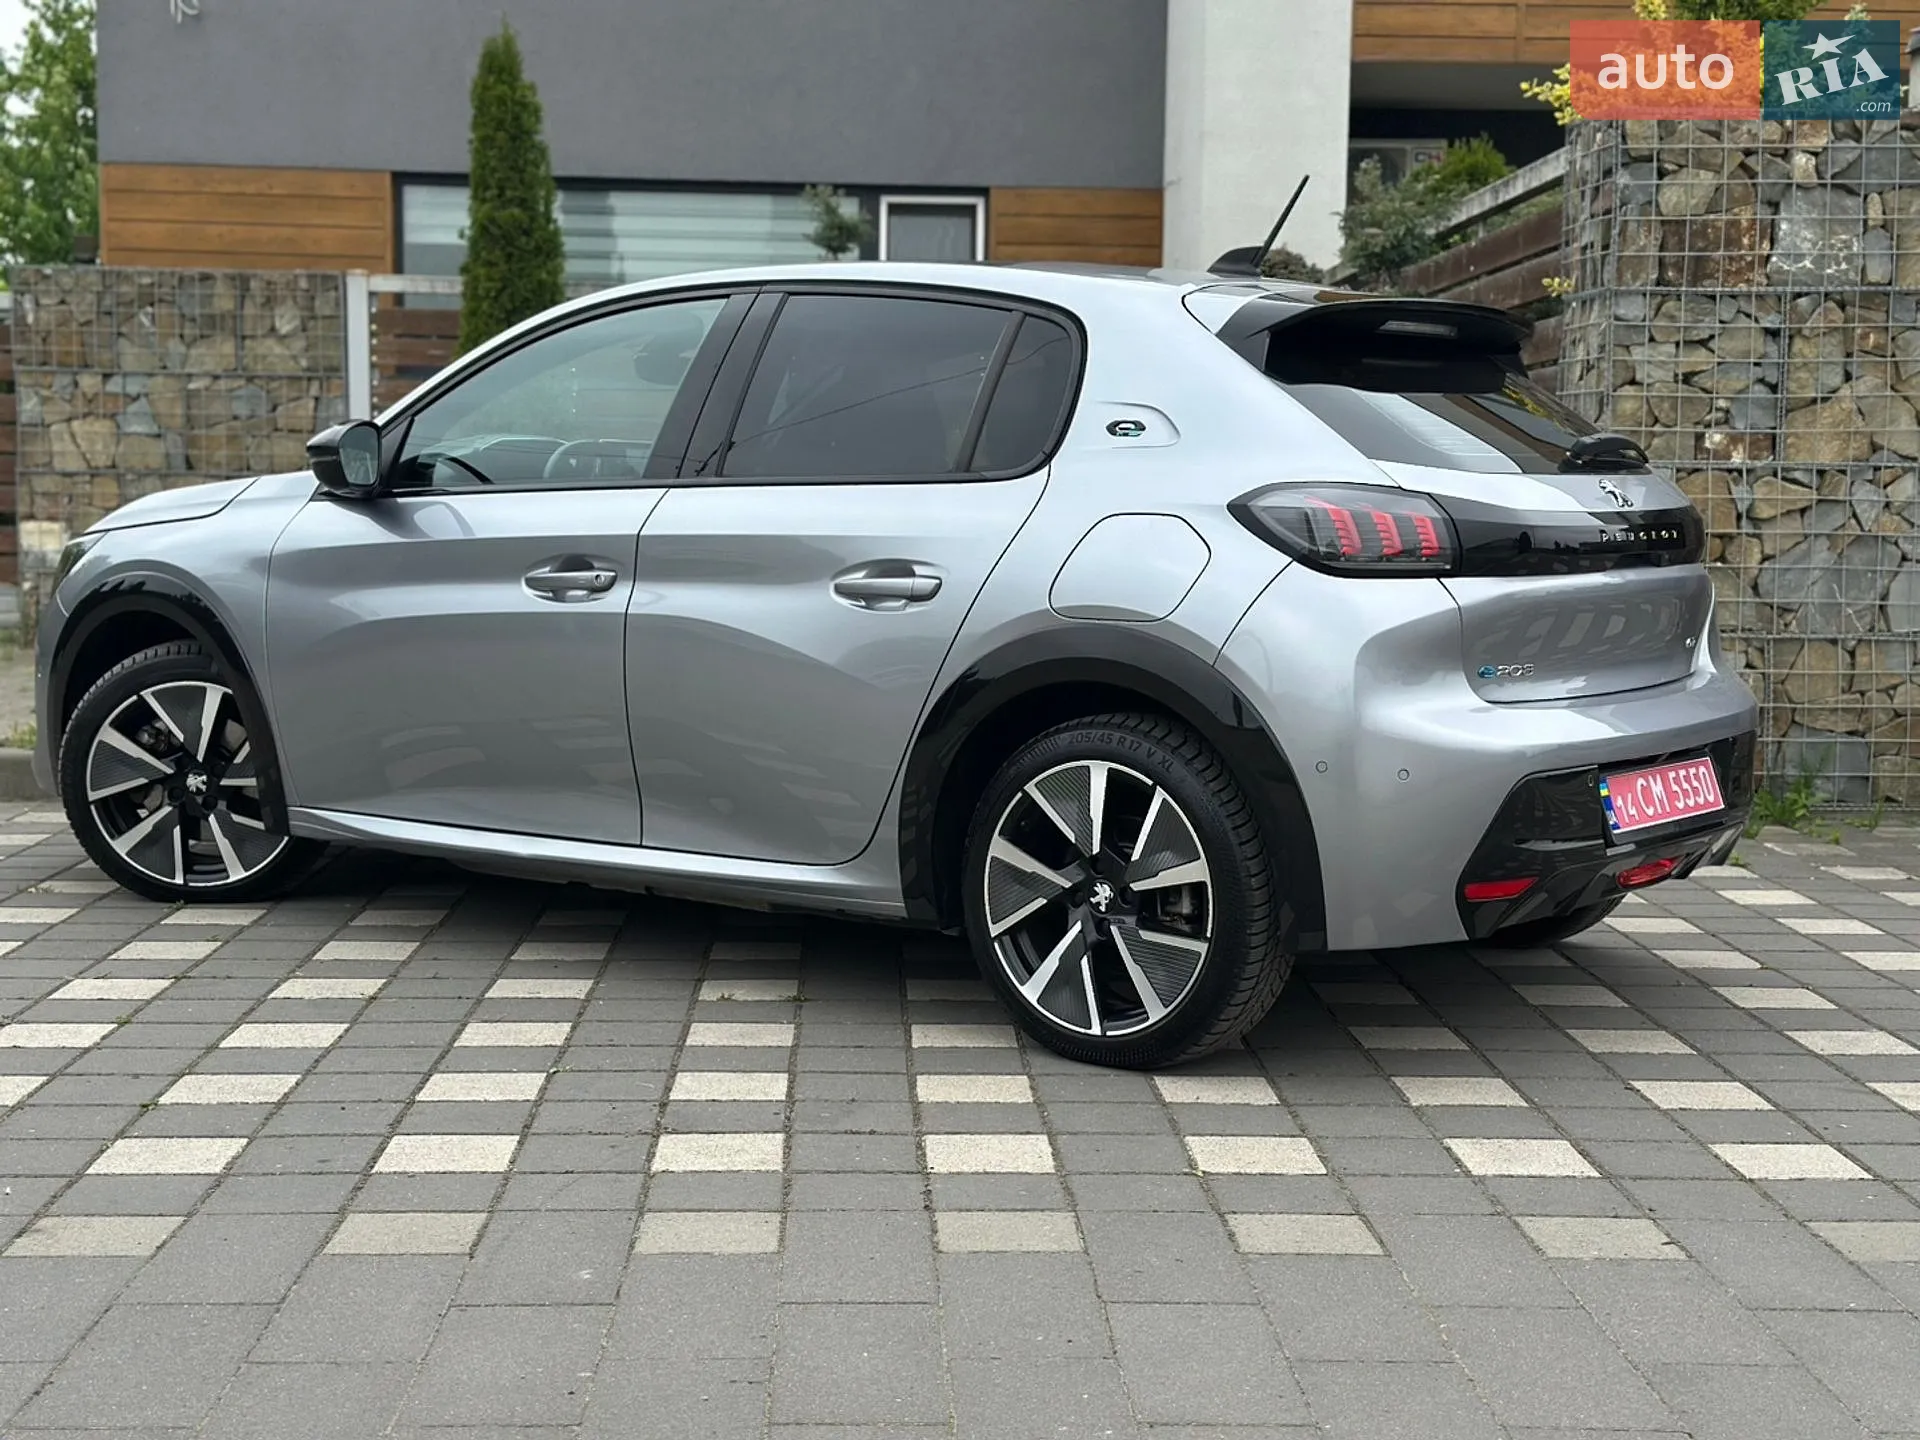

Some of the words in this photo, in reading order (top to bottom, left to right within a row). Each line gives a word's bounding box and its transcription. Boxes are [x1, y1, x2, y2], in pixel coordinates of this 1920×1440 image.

[1068, 732, 1115, 745] 205/45
[1158, 755, 1174, 773] XL
[1616, 792, 1640, 824] 14
[1636, 774, 1671, 817] CM
[1668, 765, 1715, 810] 5550
